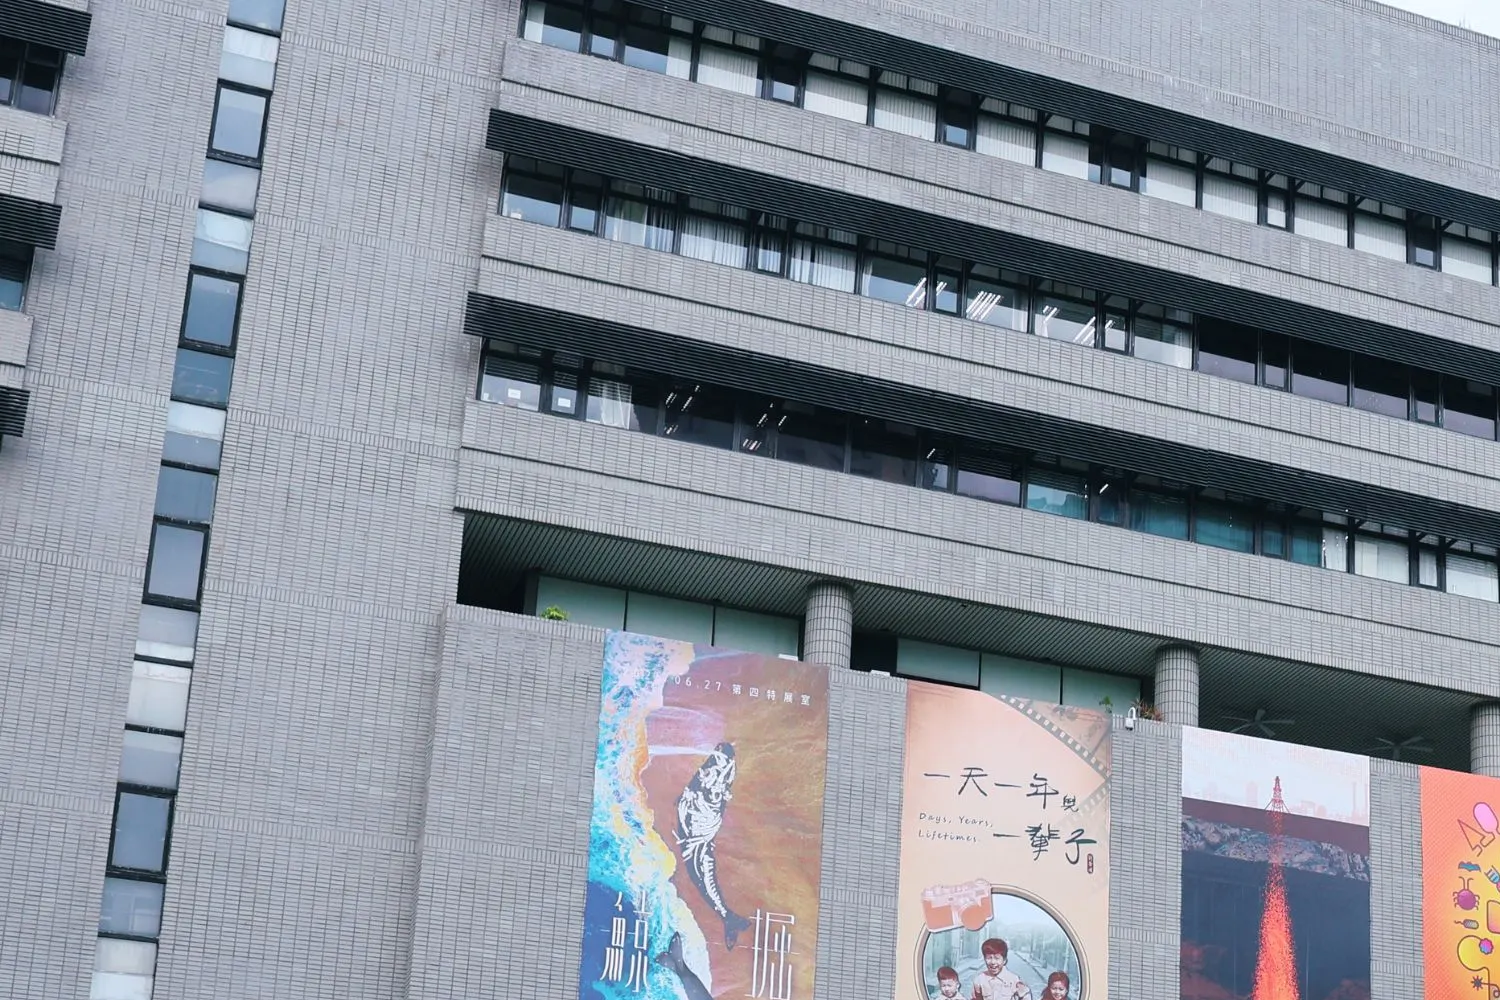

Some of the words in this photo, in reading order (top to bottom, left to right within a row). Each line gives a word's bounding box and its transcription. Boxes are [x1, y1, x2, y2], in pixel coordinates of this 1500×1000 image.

[732, 684, 811, 706] 第四特展室
[919, 812, 952, 825] Days,
[958, 815, 994, 828] Years,
[993, 823, 1097, 865] 一輩子
